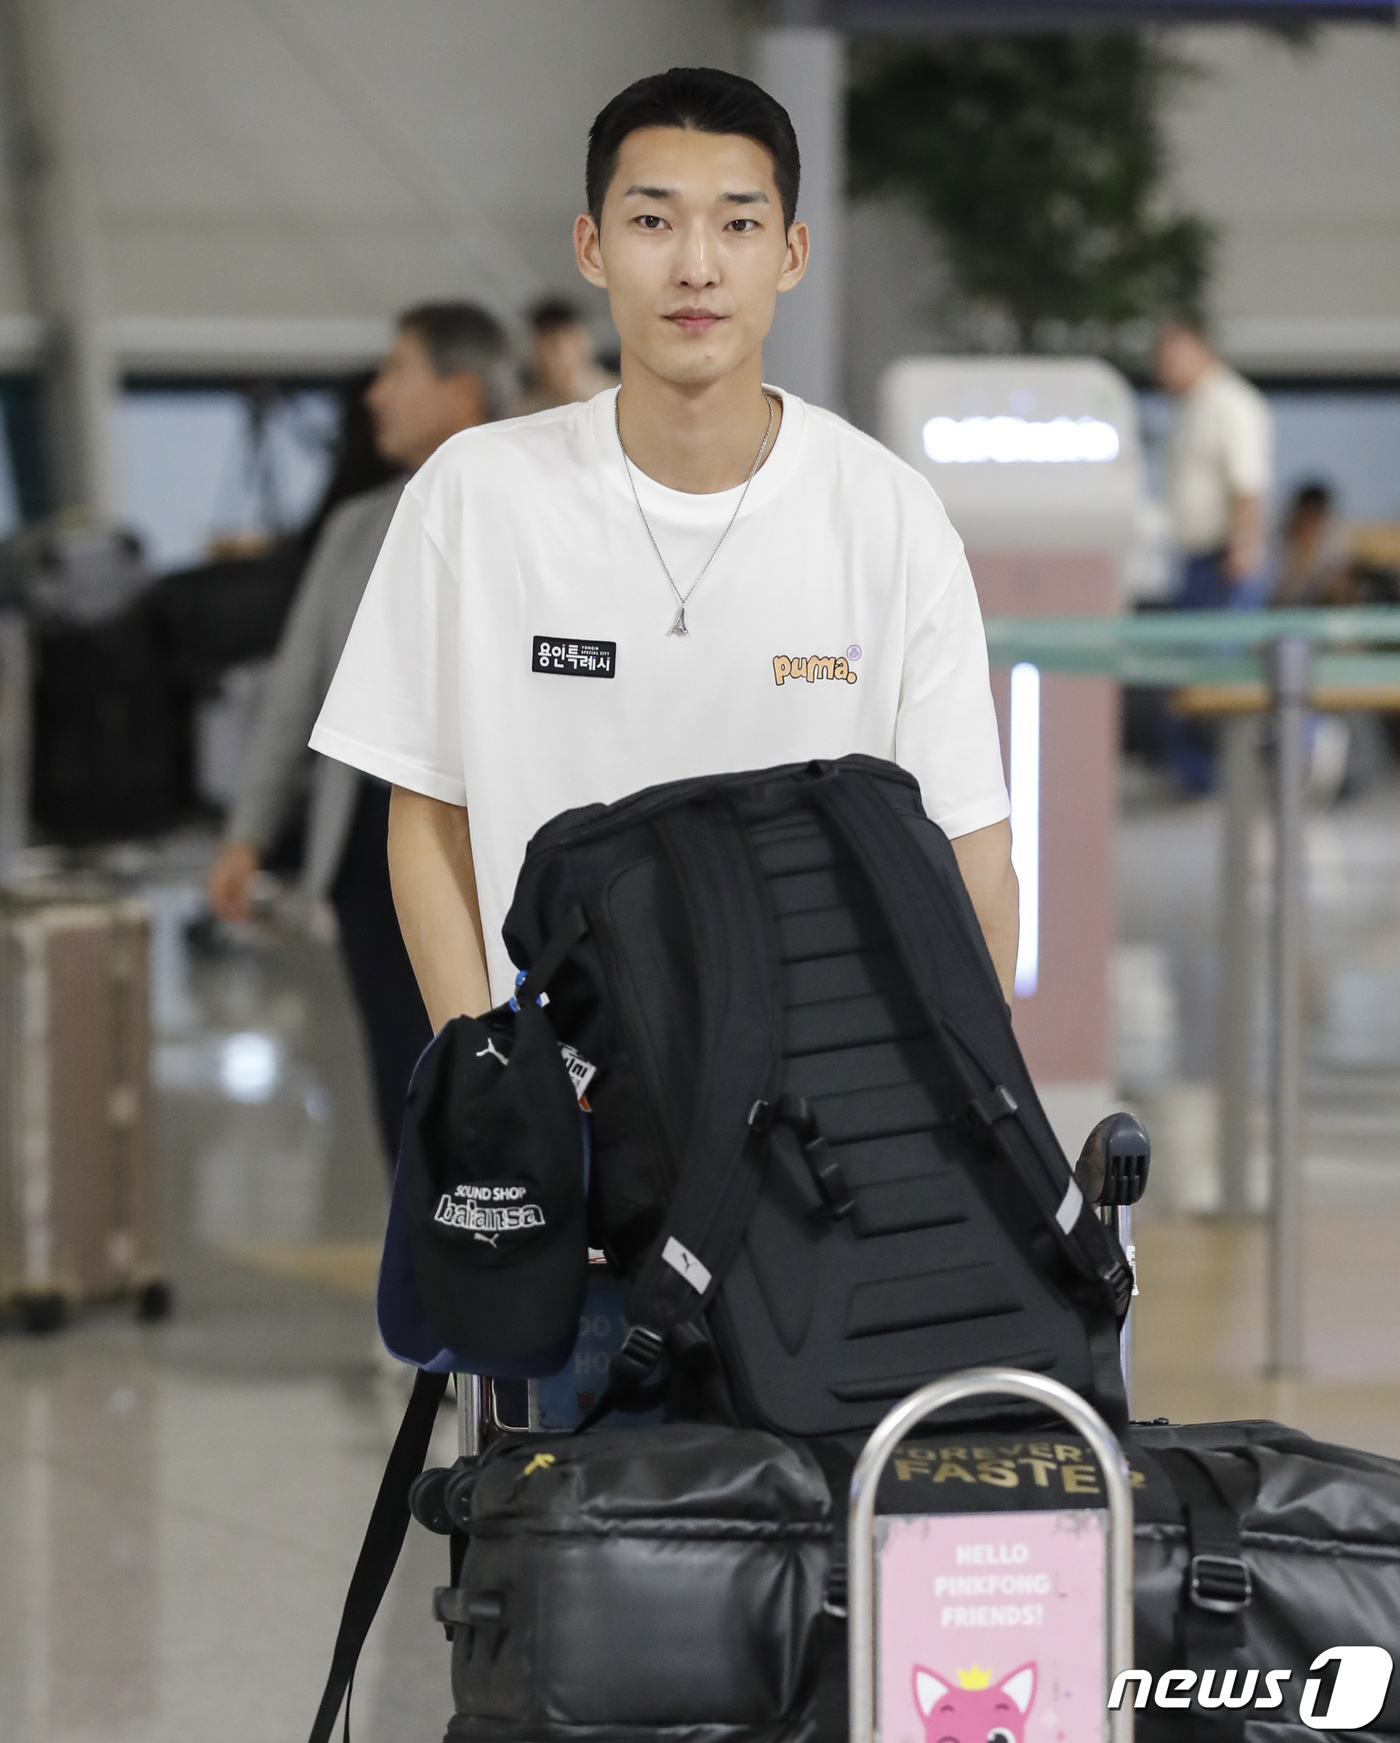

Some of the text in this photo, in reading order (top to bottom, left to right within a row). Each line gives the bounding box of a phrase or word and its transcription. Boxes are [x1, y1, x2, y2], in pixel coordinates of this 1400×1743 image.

[538, 642, 611, 672] 용인특례시
[454, 1184, 527, 1201] SOUND SHOP
[434, 1194, 546, 1231] balansa
[955, 1543, 1030, 1566] HELLO
[933, 1573, 1051, 1597] PINKFONG
[941, 1605, 1043, 1628] FRIENDS!
